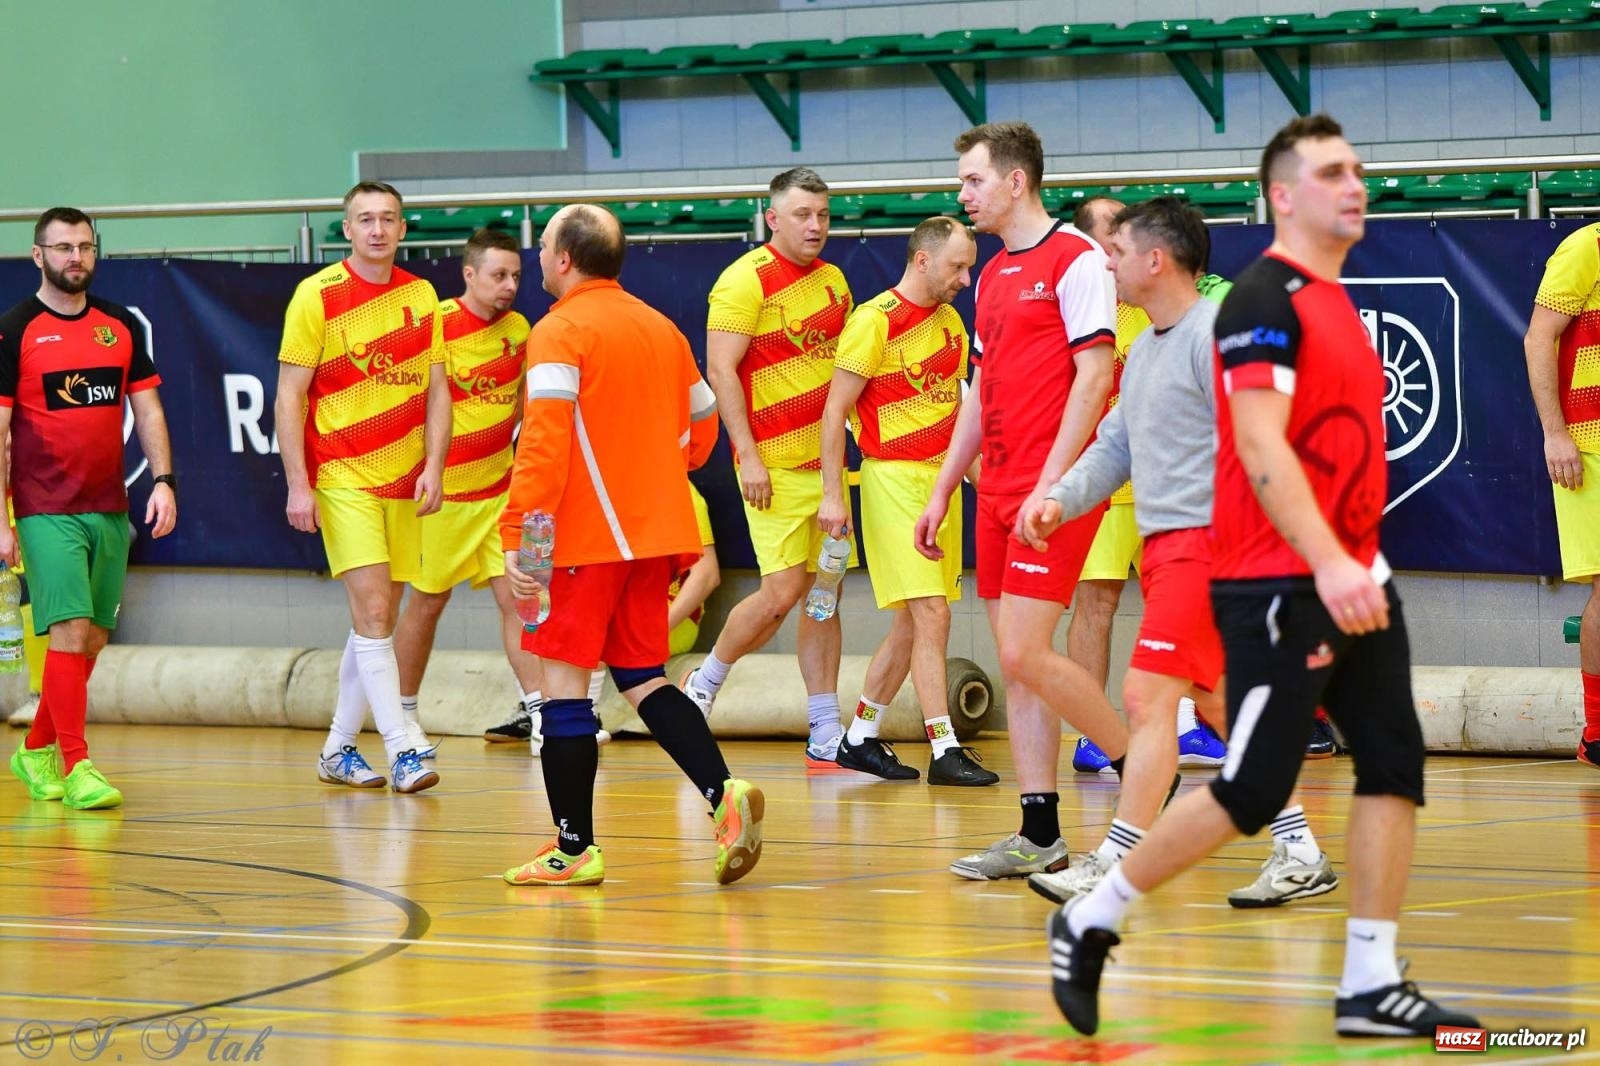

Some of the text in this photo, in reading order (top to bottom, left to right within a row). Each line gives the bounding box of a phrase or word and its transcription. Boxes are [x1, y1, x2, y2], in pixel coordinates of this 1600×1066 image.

[86, 385, 116, 404] JSW
[223, 373, 280, 455] R
[1011, 561, 1049, 574] regio
[1139, 639, 1176, 651] regio
[560, 830, 580, 841] ZEUS
